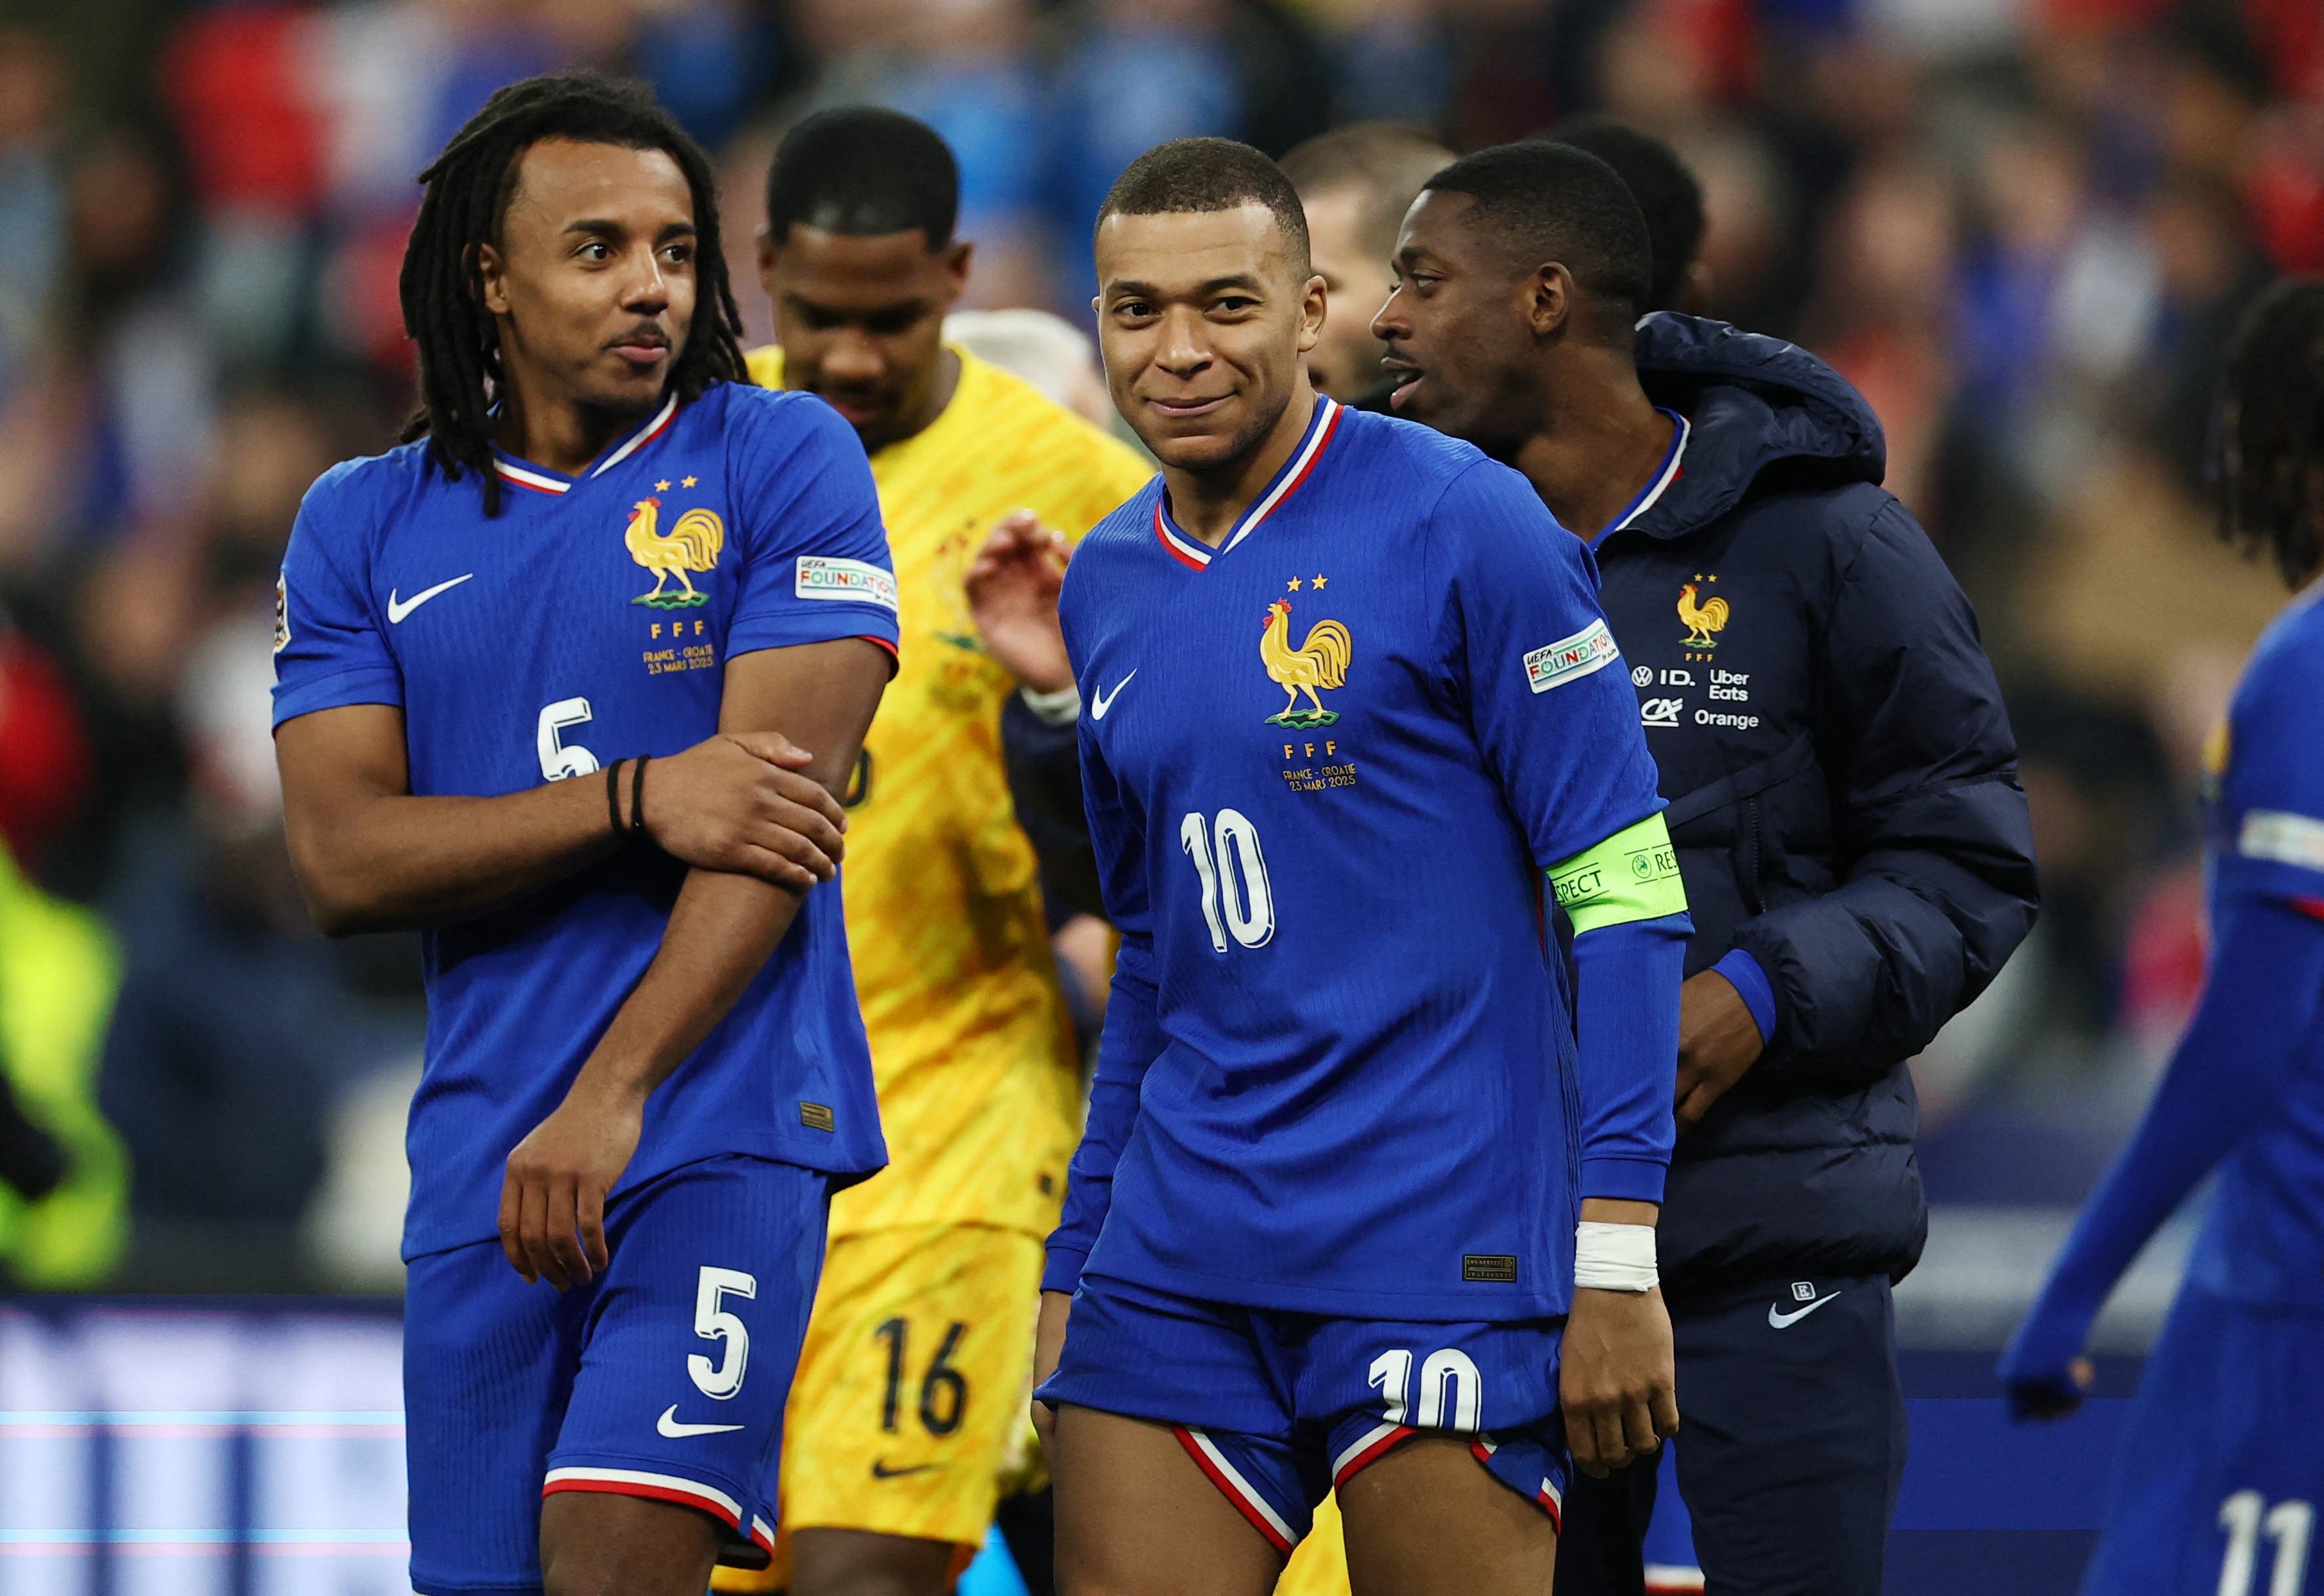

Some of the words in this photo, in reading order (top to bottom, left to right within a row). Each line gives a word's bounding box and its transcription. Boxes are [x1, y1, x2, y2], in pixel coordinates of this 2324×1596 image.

[643, 649, 675, 663] FRANCE
[648, 662, 662, 675] 23
[664, 660, 687, 673] MARS
[688, 656, 714, 669] 2025
[1527, 648, 1552, 665] UEFA
[1529, 630, 1612, 680] FOUNDATION
[1709, 669, 1750, 685] Uber
[1709, 685, 1749, 701] Eats
[1694, 709, 1759, 730] Orange
[537, 696, 600, 782] 5
[1283, 768, 1313, 780] FRANCE
[1321, 763, 1357, 777] CROATIE
[1289, 781, 1302, 792] 23
[1303, 779, 1327, 790] MARS
[1329, 775, 1356, 788] 2025
[1180, 808, 1275, 953] 10
[687, 1266, 757, 1400] 5
[874, 1317, 968, 1436] 16
[1368, 1348, 1482, 1433] 10
[2216, 1488, 2315, 1596] 11
